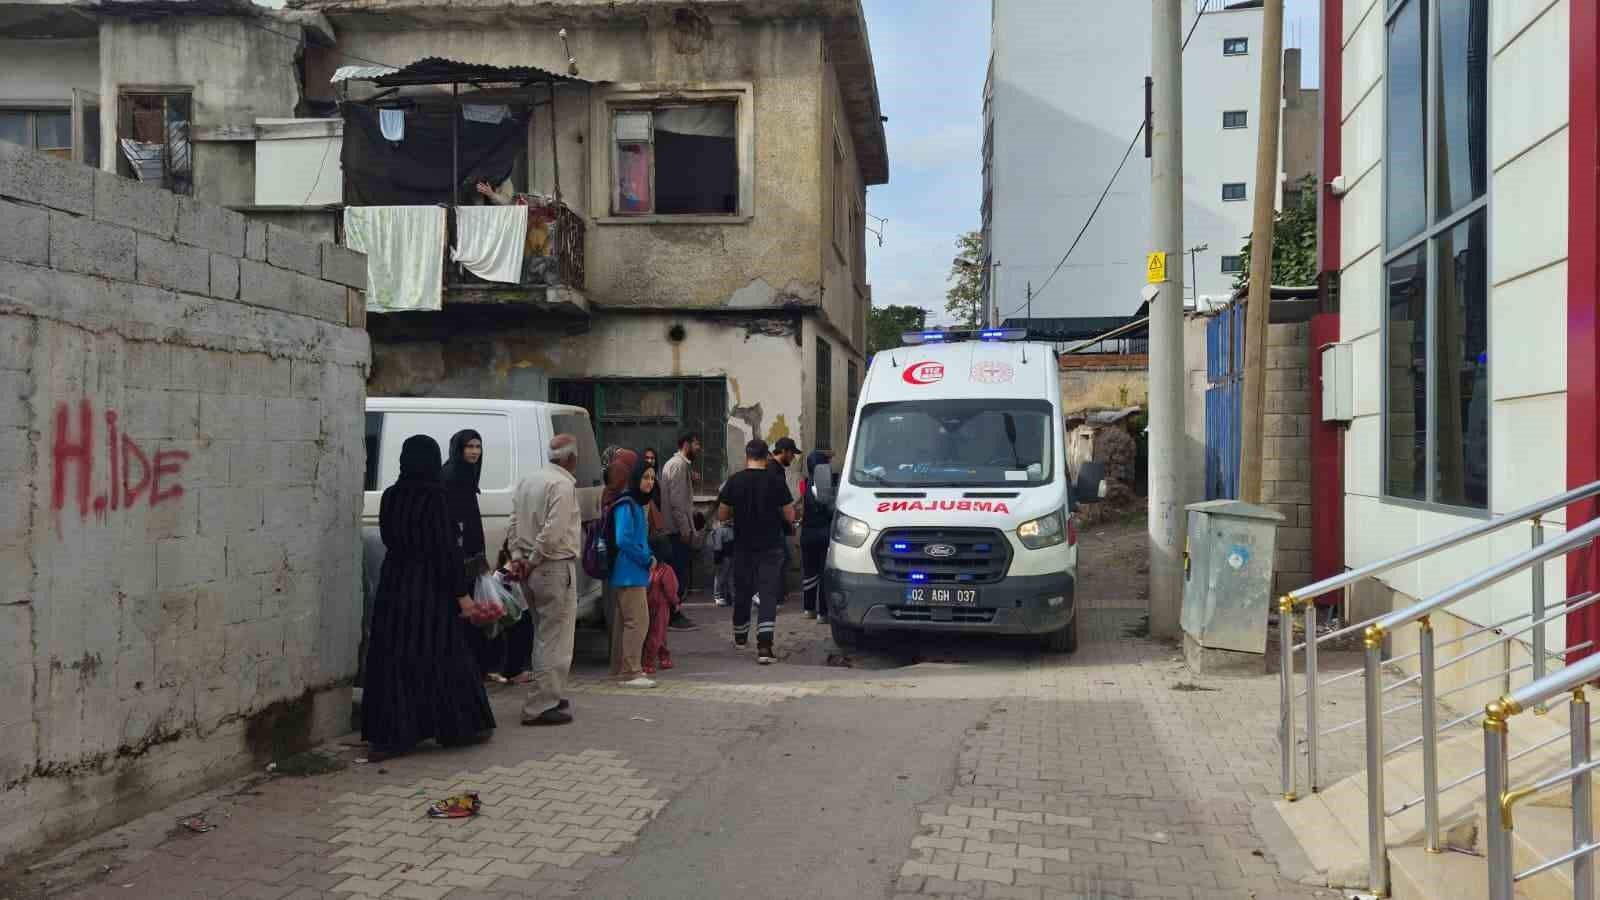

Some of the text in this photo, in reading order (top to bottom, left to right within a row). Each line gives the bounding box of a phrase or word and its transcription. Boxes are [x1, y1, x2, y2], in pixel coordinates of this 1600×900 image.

[912, 588, 976, 602] 02 AGH 037
